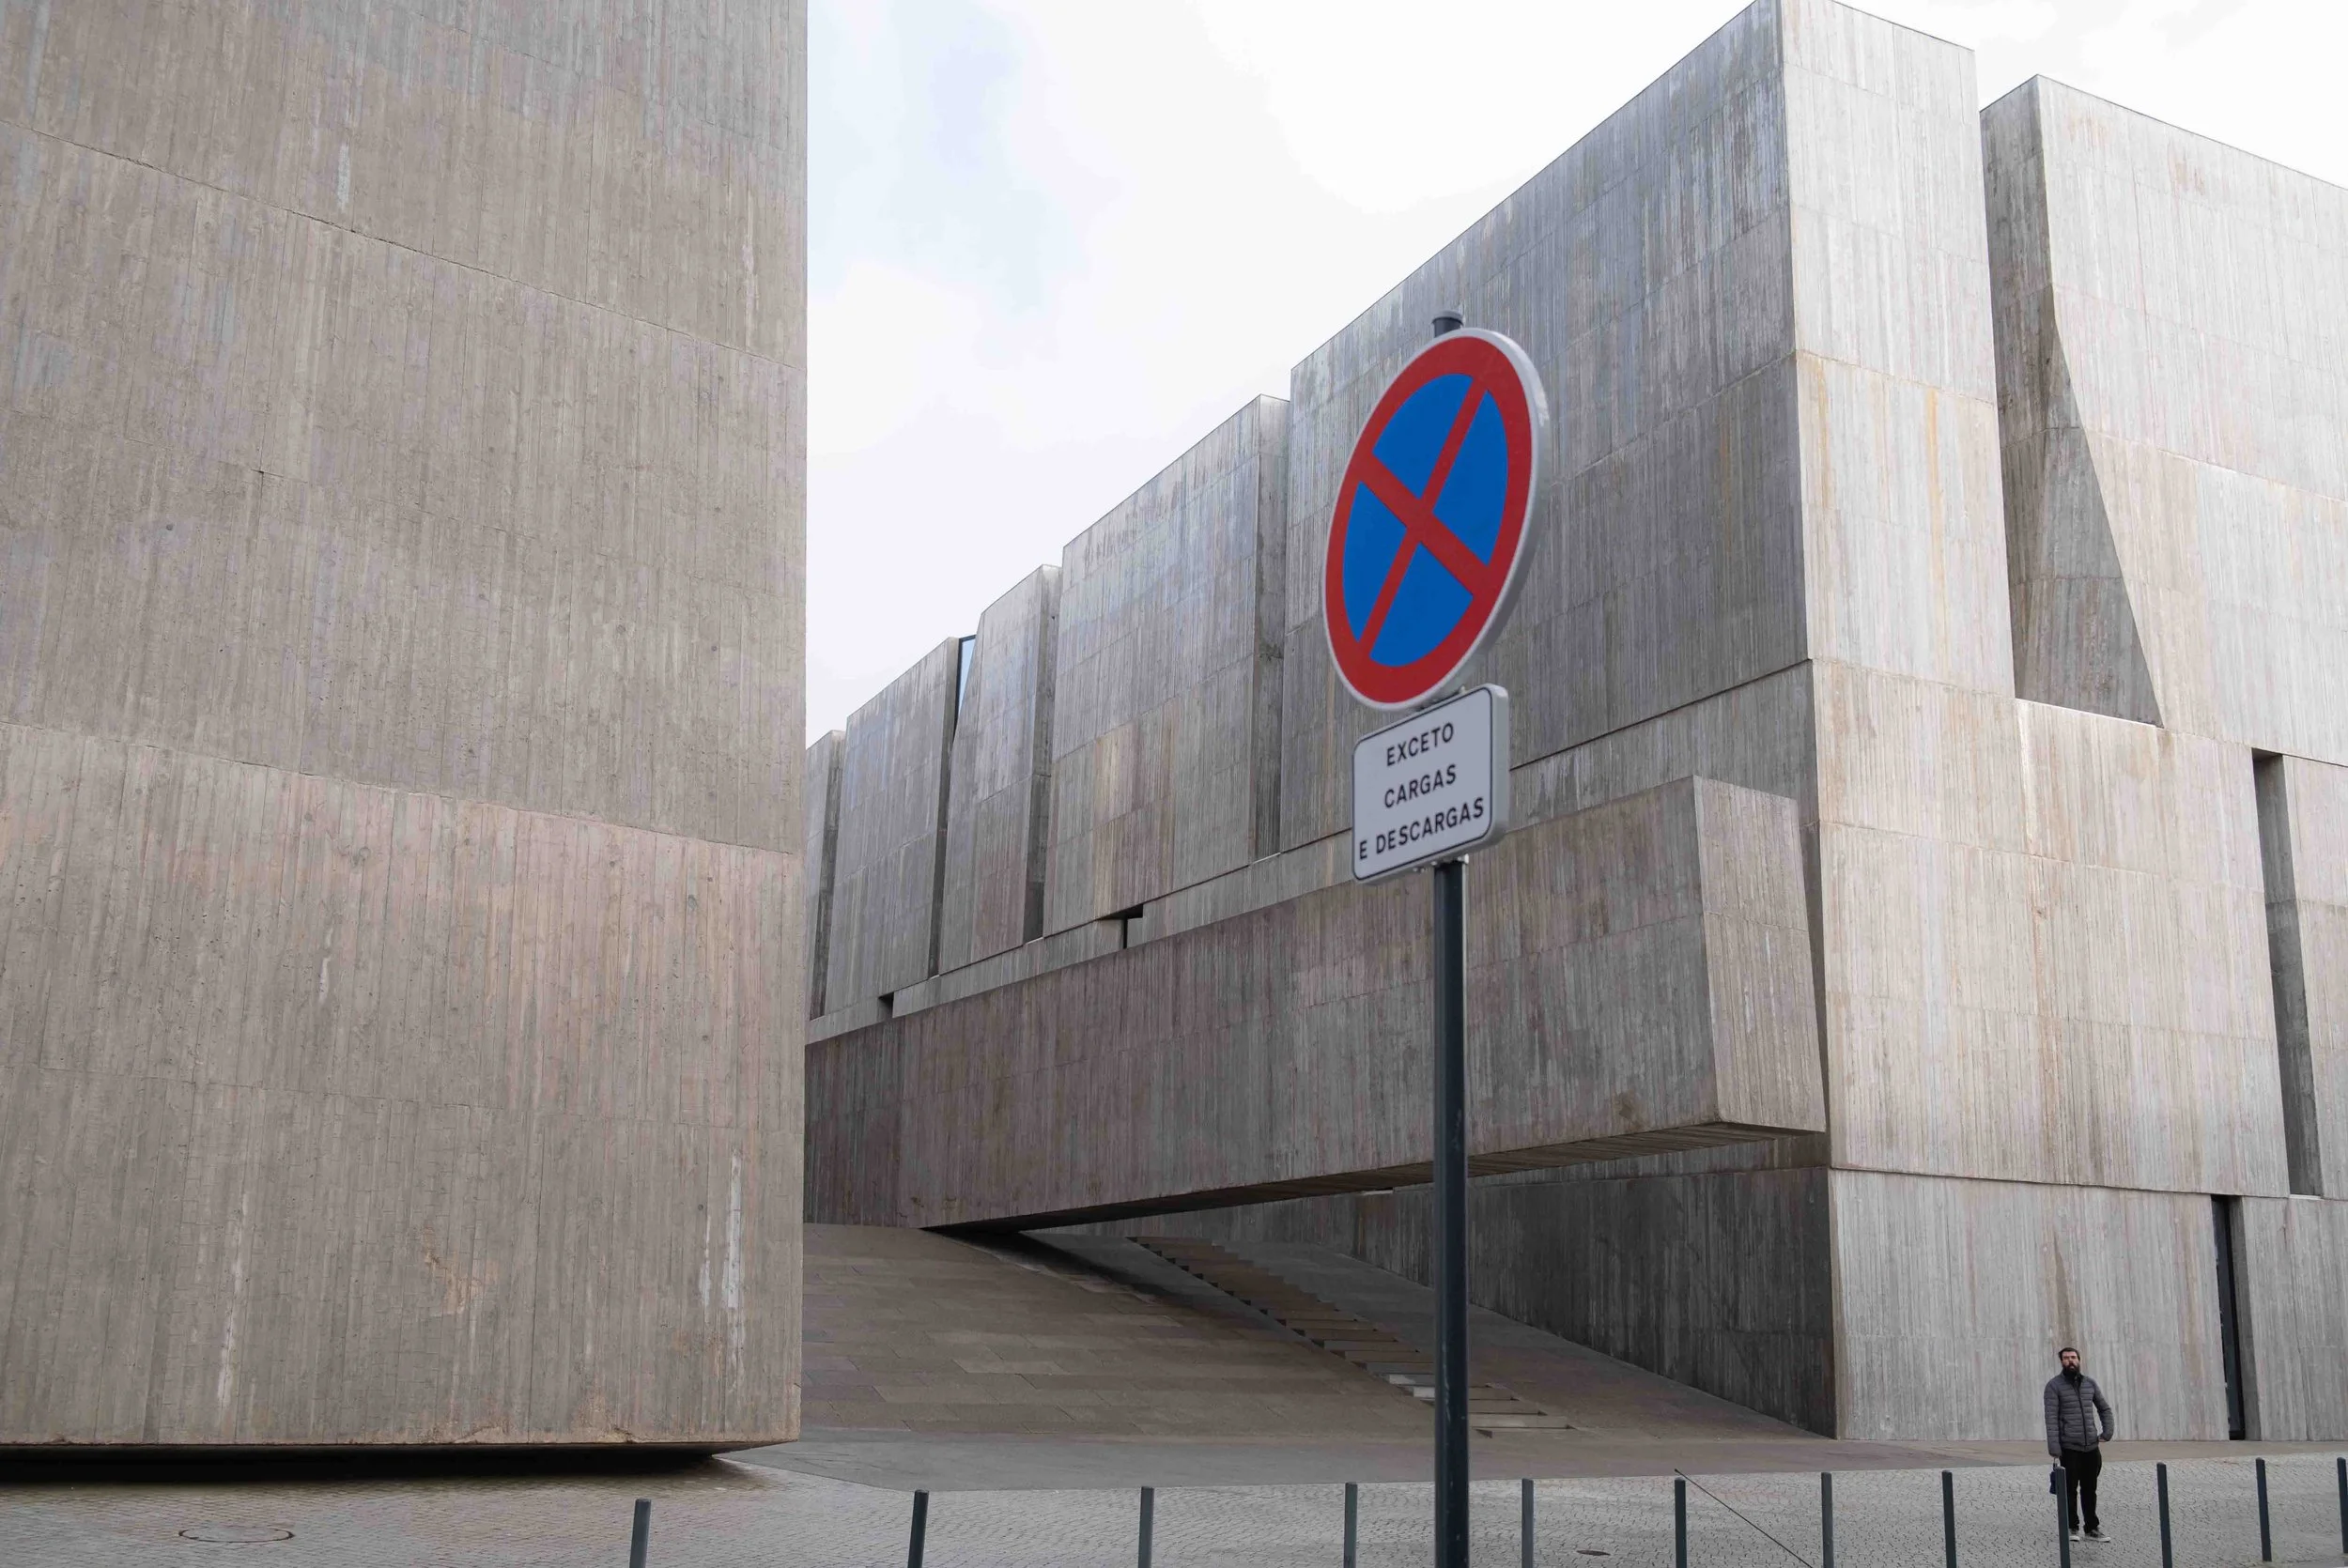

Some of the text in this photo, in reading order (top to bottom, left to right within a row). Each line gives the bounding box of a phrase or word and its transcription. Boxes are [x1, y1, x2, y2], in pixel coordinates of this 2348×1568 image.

[1386, 722, 1454, 766] EXCETO
[1384, 763, 1457, 808] CARGAS
[1359, 797, 1484, 859] E DESCARGAS
